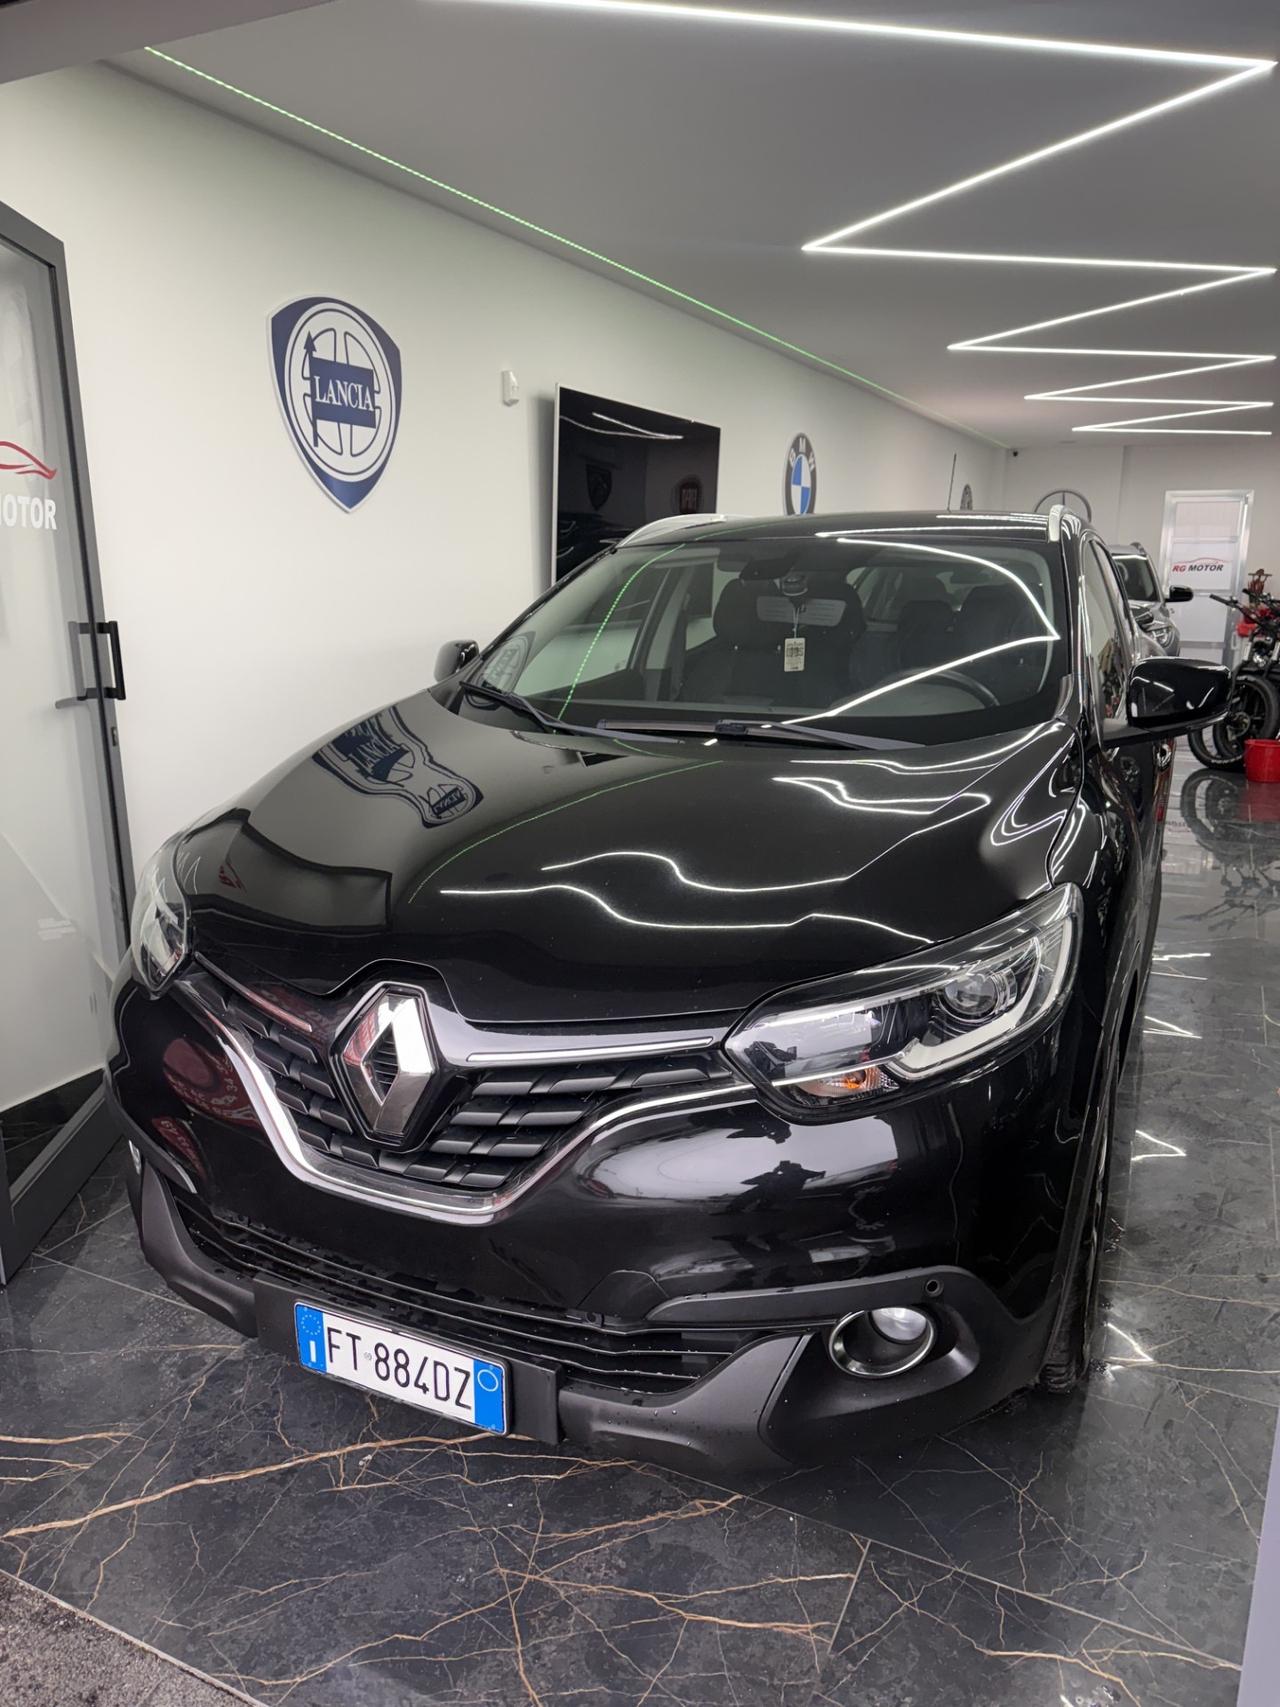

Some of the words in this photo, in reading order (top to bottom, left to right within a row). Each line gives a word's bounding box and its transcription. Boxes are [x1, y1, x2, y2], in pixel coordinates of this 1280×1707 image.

[313, 375, 374, 412] LANCIA
[0, 494, 57, 530] OTOR
[1172, 565, 1188, 573] RG
[1188, 564, 1224, 572] MOTOR
[373, 1342, 472, 1410] 884DZ
